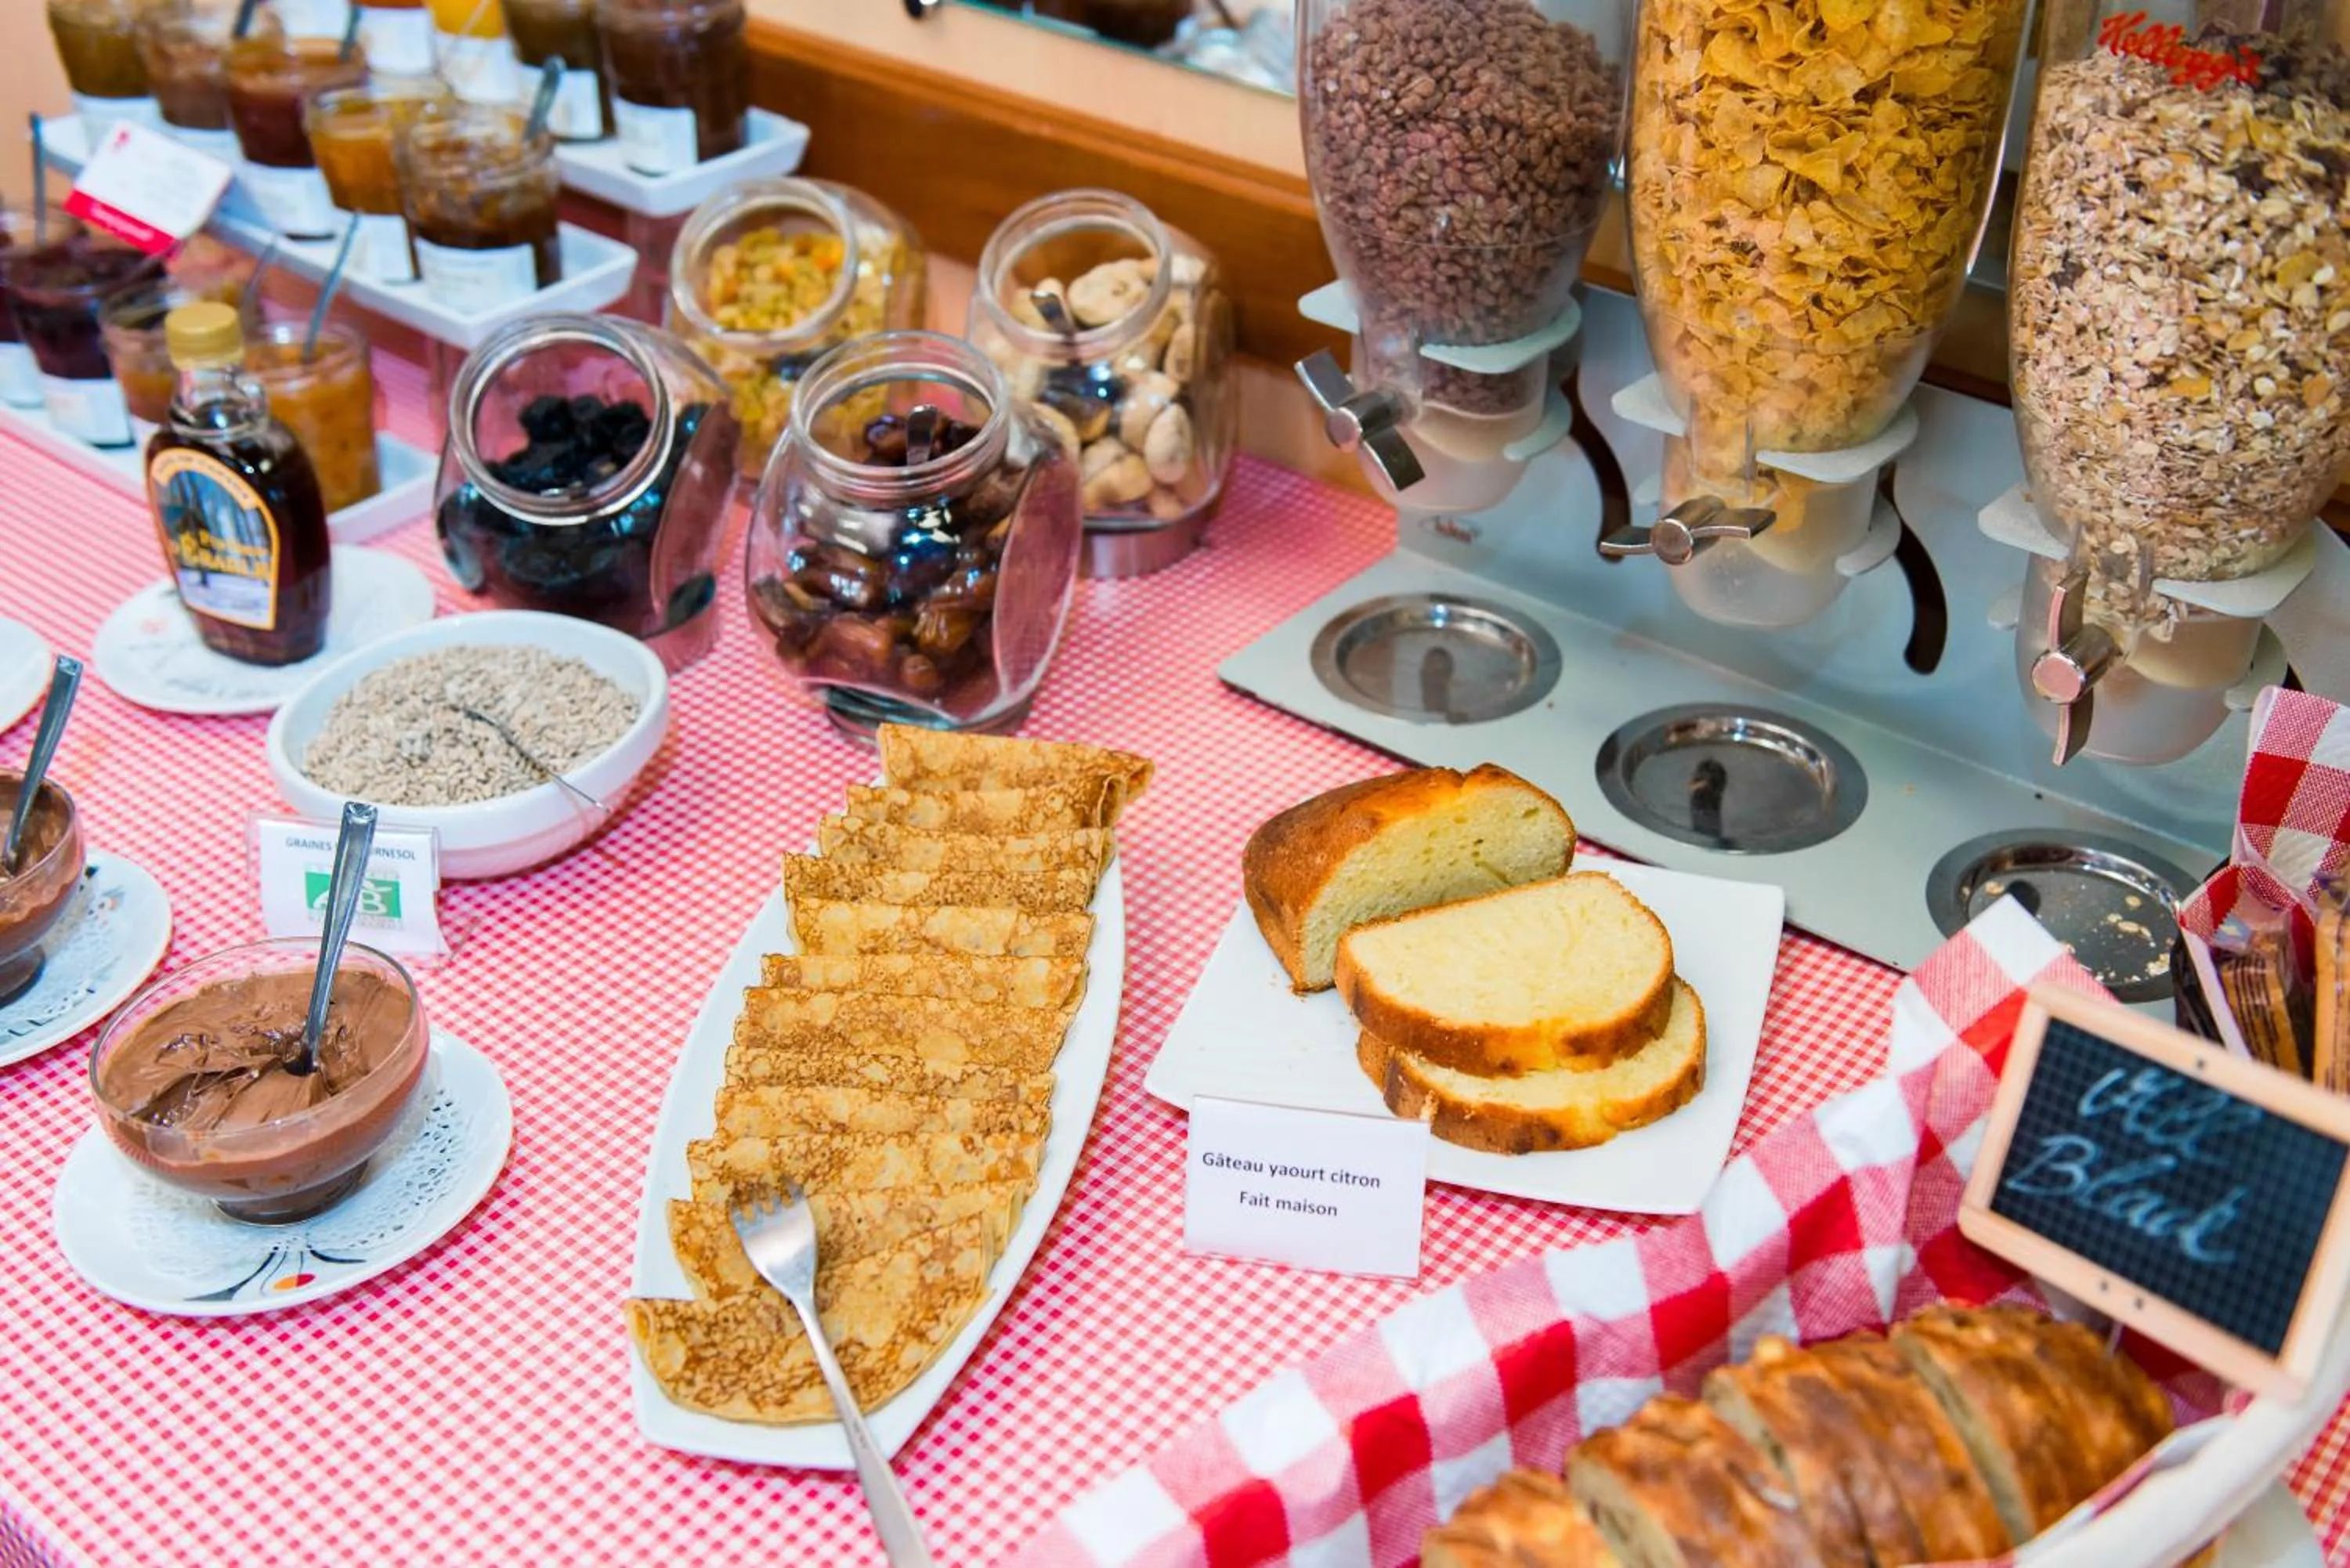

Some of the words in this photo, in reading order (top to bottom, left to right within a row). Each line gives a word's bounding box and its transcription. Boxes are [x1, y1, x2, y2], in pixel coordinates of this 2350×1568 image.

[285, 836, 332, 851] GRAINES
[372, 846, 417, 861] RNESOL
[1202, 1151, 1264, 1173] Gâteau
[1268, 1163, 1325, 1181] yaourt
[1330, 1169, 1381, 1189] citron
[1239, 1190, 1270, 1209] Fait
[1275, 1198, 1338, 1216] maison
